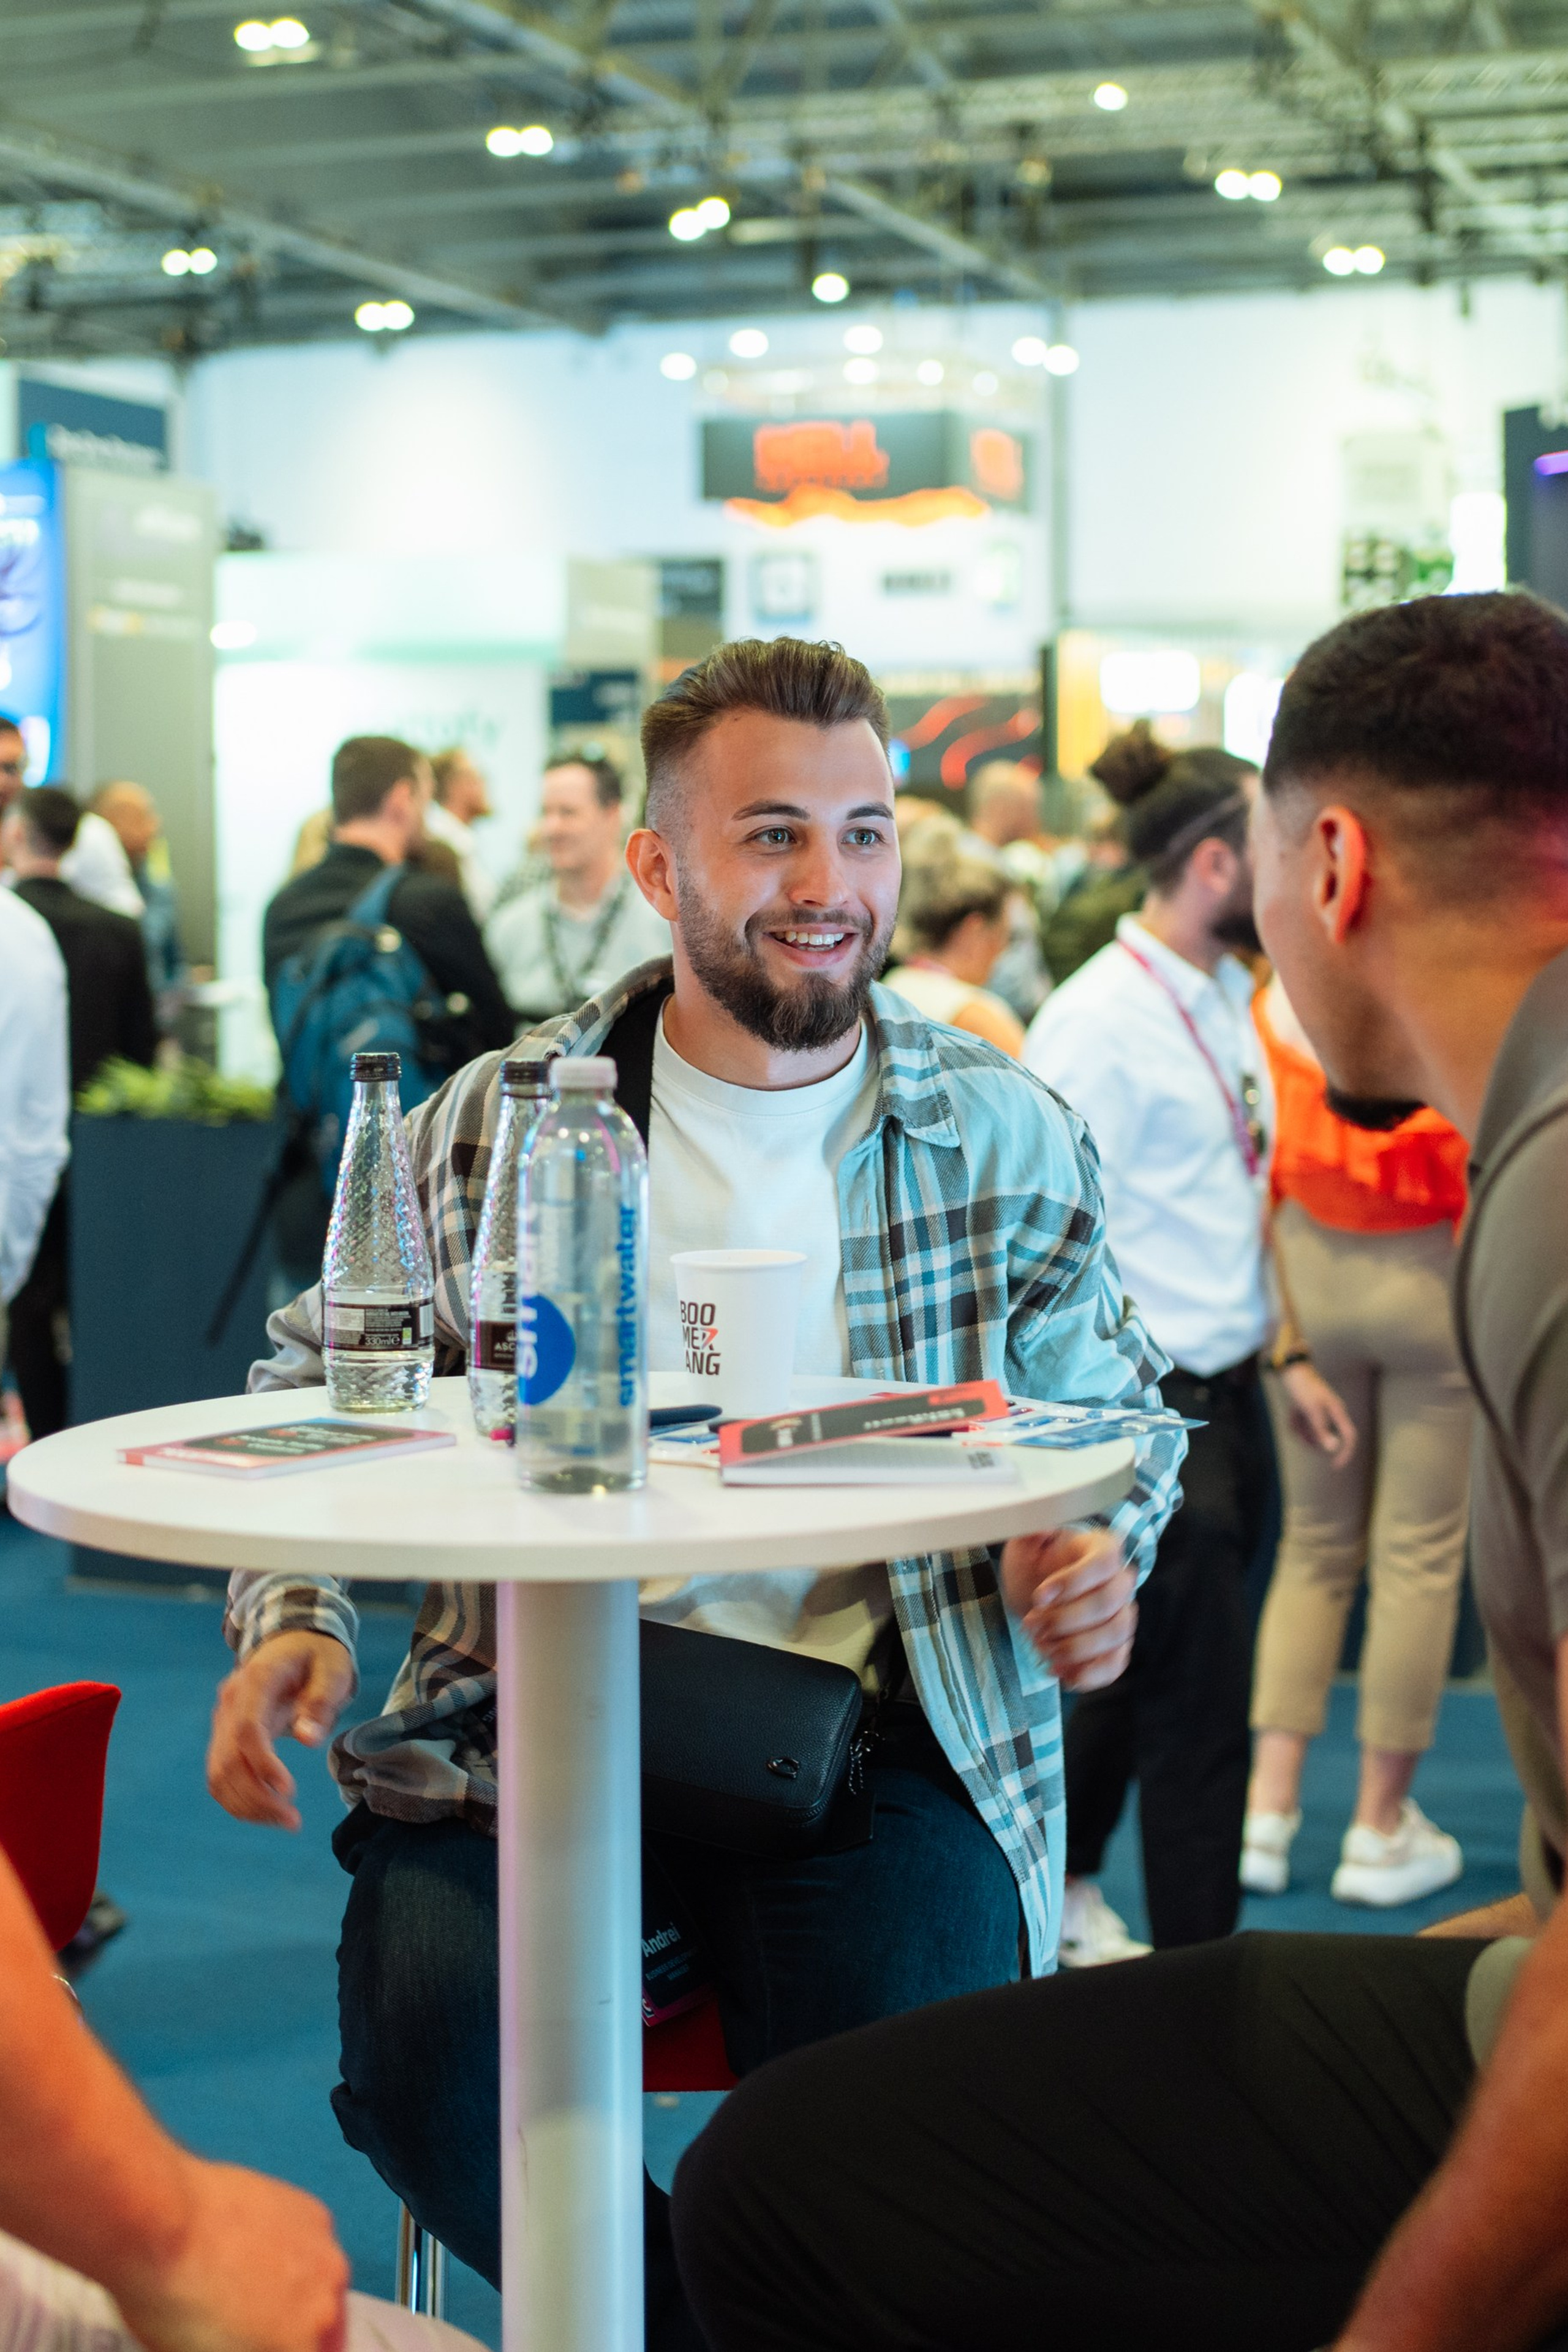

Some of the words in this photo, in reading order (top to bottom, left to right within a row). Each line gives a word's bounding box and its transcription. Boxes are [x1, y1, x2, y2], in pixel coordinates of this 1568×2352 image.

[616, 1204, 635, 1407] smartwater
[680, 1300, 716, 1326] BOO
[685, 1349, 721, 1376] ANG
[641, 1921, 681, 1958] Andrei
